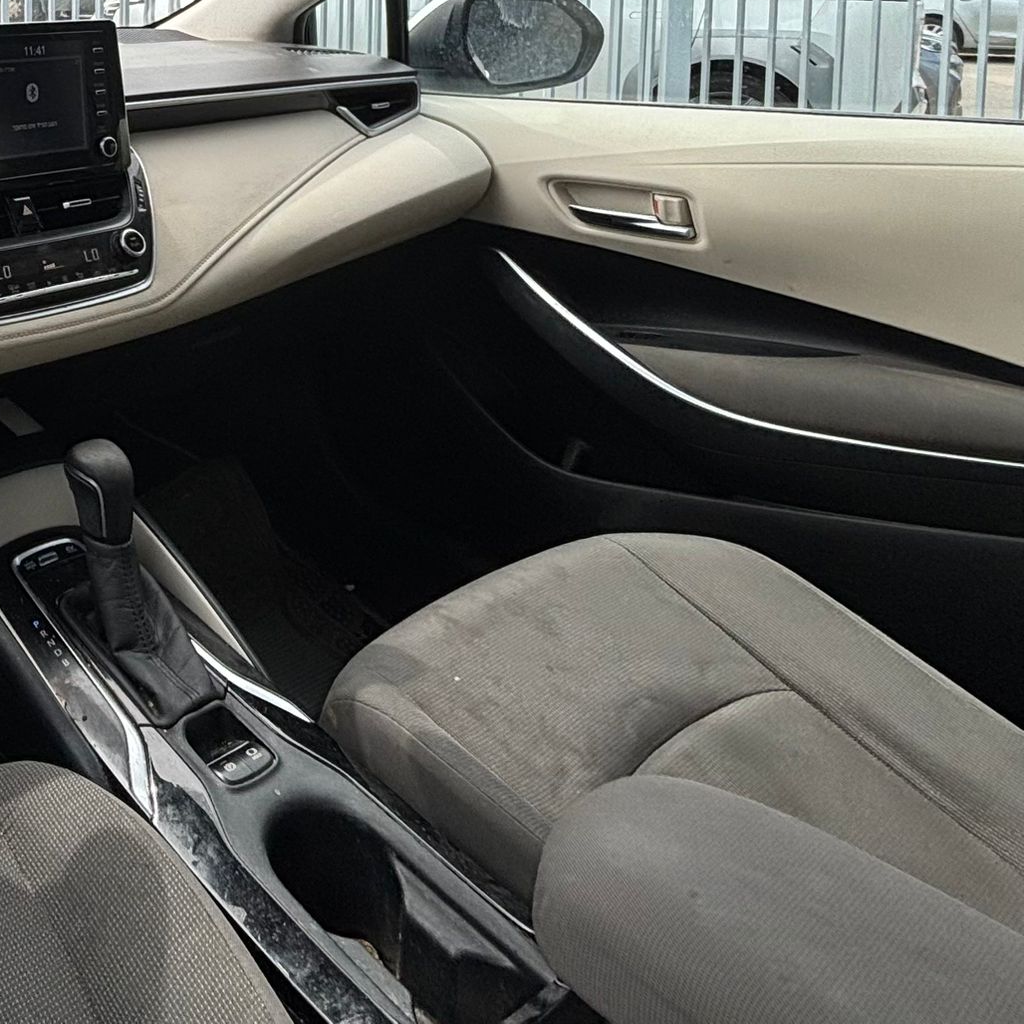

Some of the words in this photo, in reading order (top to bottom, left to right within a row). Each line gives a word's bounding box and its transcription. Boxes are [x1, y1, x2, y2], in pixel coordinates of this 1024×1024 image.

[24, 45, 46, 57] 11:41
[83, 247, 101, 263] LO
[33, 620, 40, 628] P
[40, 630, 48, 638] R
[47, 638, 56, 647] N
[54, 649, 62, 657] D
